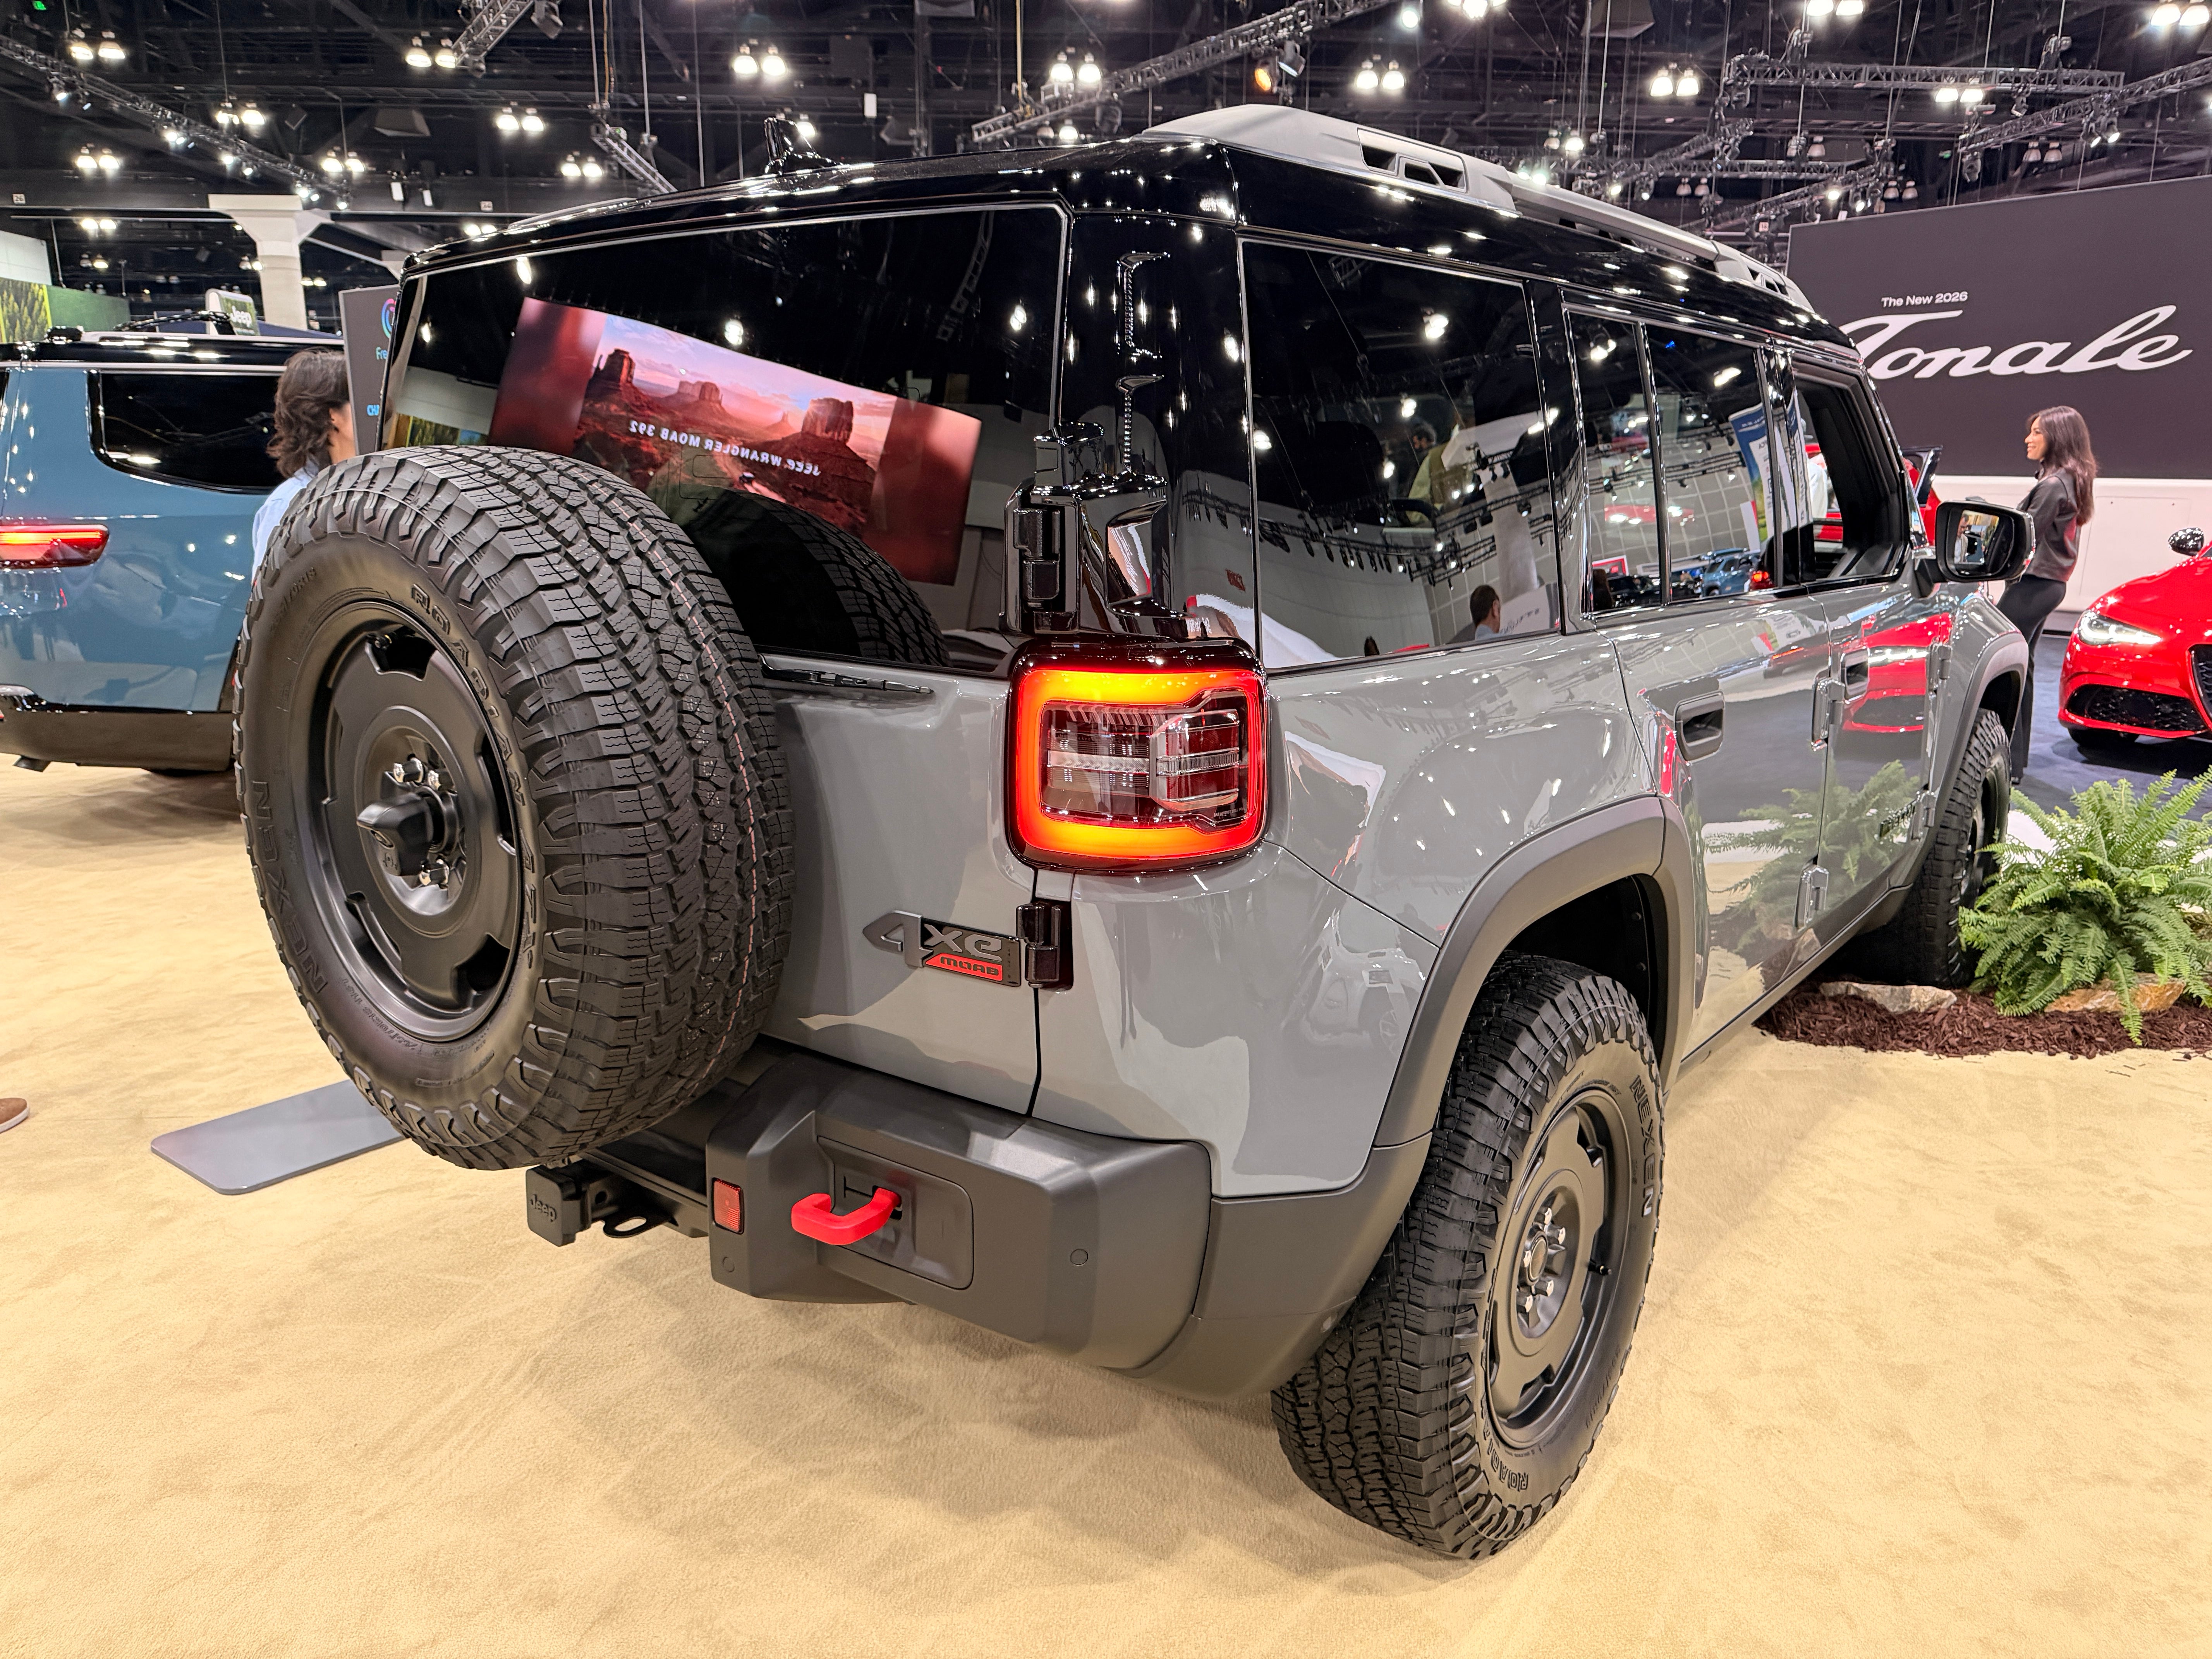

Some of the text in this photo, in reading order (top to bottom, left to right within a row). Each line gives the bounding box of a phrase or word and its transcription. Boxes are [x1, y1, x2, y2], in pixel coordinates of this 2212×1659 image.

[1881, 291, 1968, 307] The New 2026
[230, 305, 252, 328] Jeep
[1838, 305, 2193, 379] Tonale
[252, 780, 328, 994] NEXEN
[940, 956, 1000, 976] MOAB
[1630, 1075, 1655, 1218] NEXEN
[530, 1194, 557, 1222] Jeep
